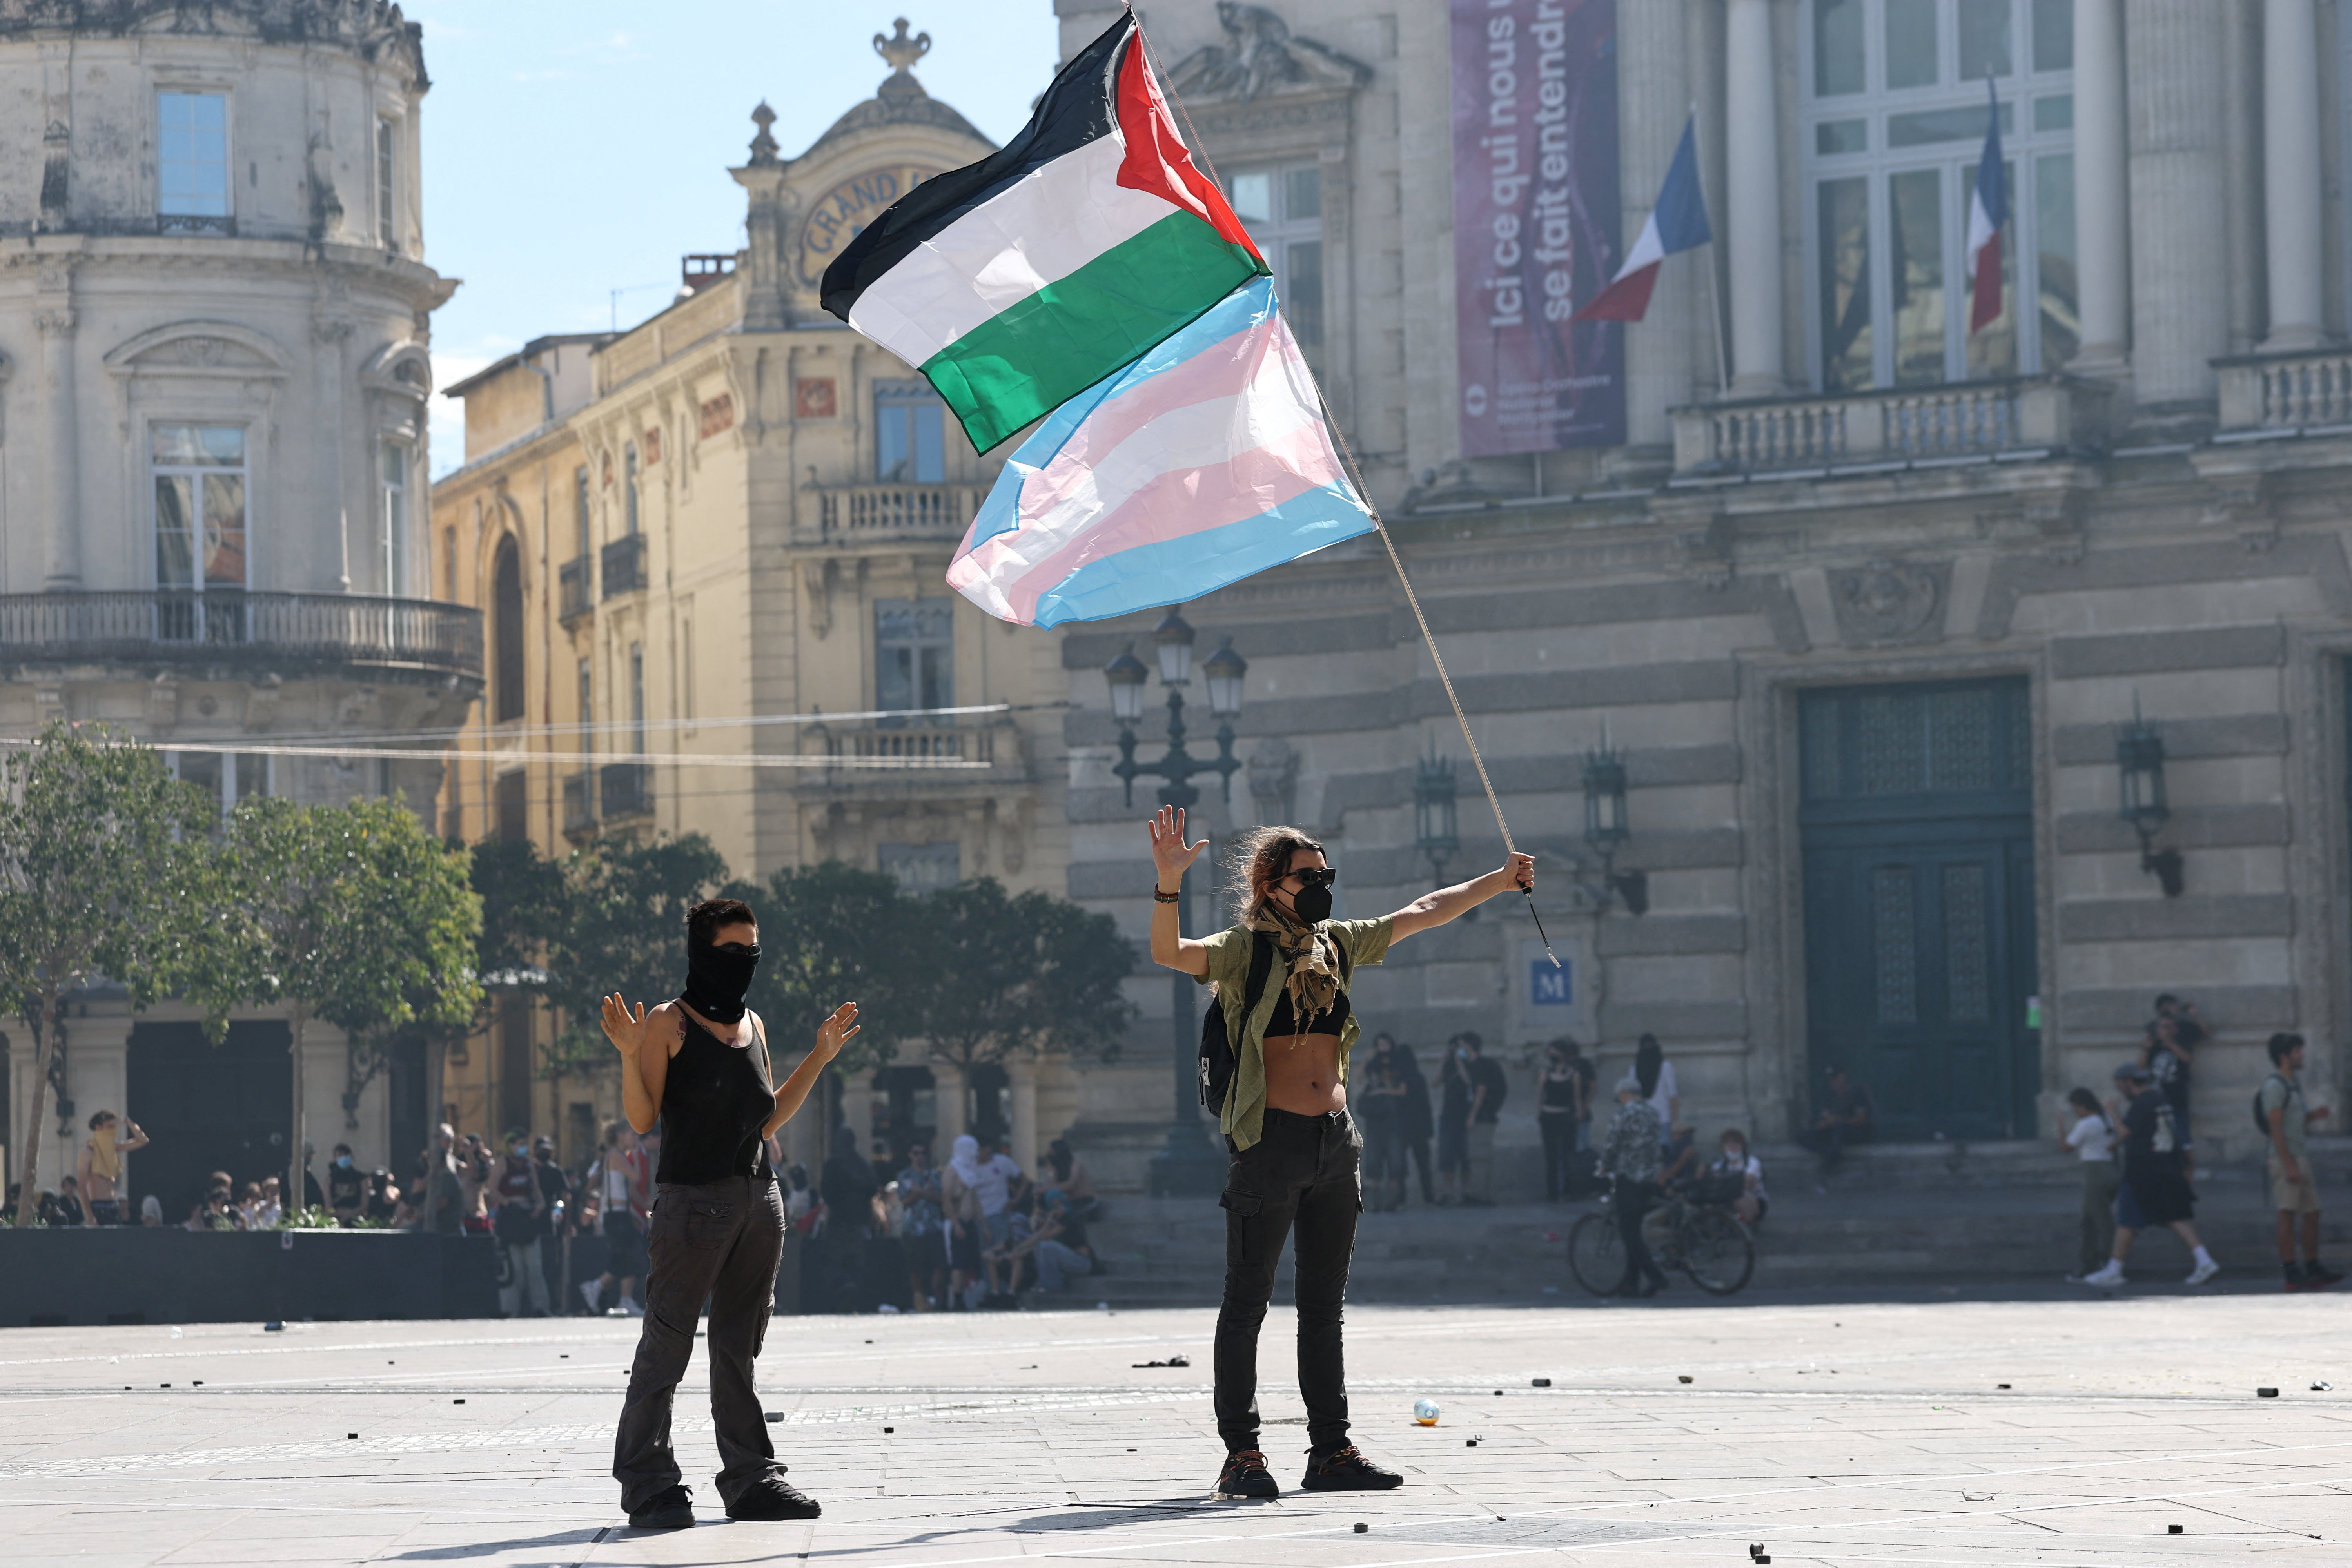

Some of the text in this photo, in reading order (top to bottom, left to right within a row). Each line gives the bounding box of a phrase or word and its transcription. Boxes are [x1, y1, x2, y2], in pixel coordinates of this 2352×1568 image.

[1488, 15, 1517, 127] nous
[1481, 134, 1530, 206] qui
[1529, 0, 1573, 321] se fait entendr
[807, 173, 898, 254] GRAND
[1493, 212, 1522, 267] ce
[1485, 275, 1523, 327] Ici
[1539, 973, 1564, 999] M
